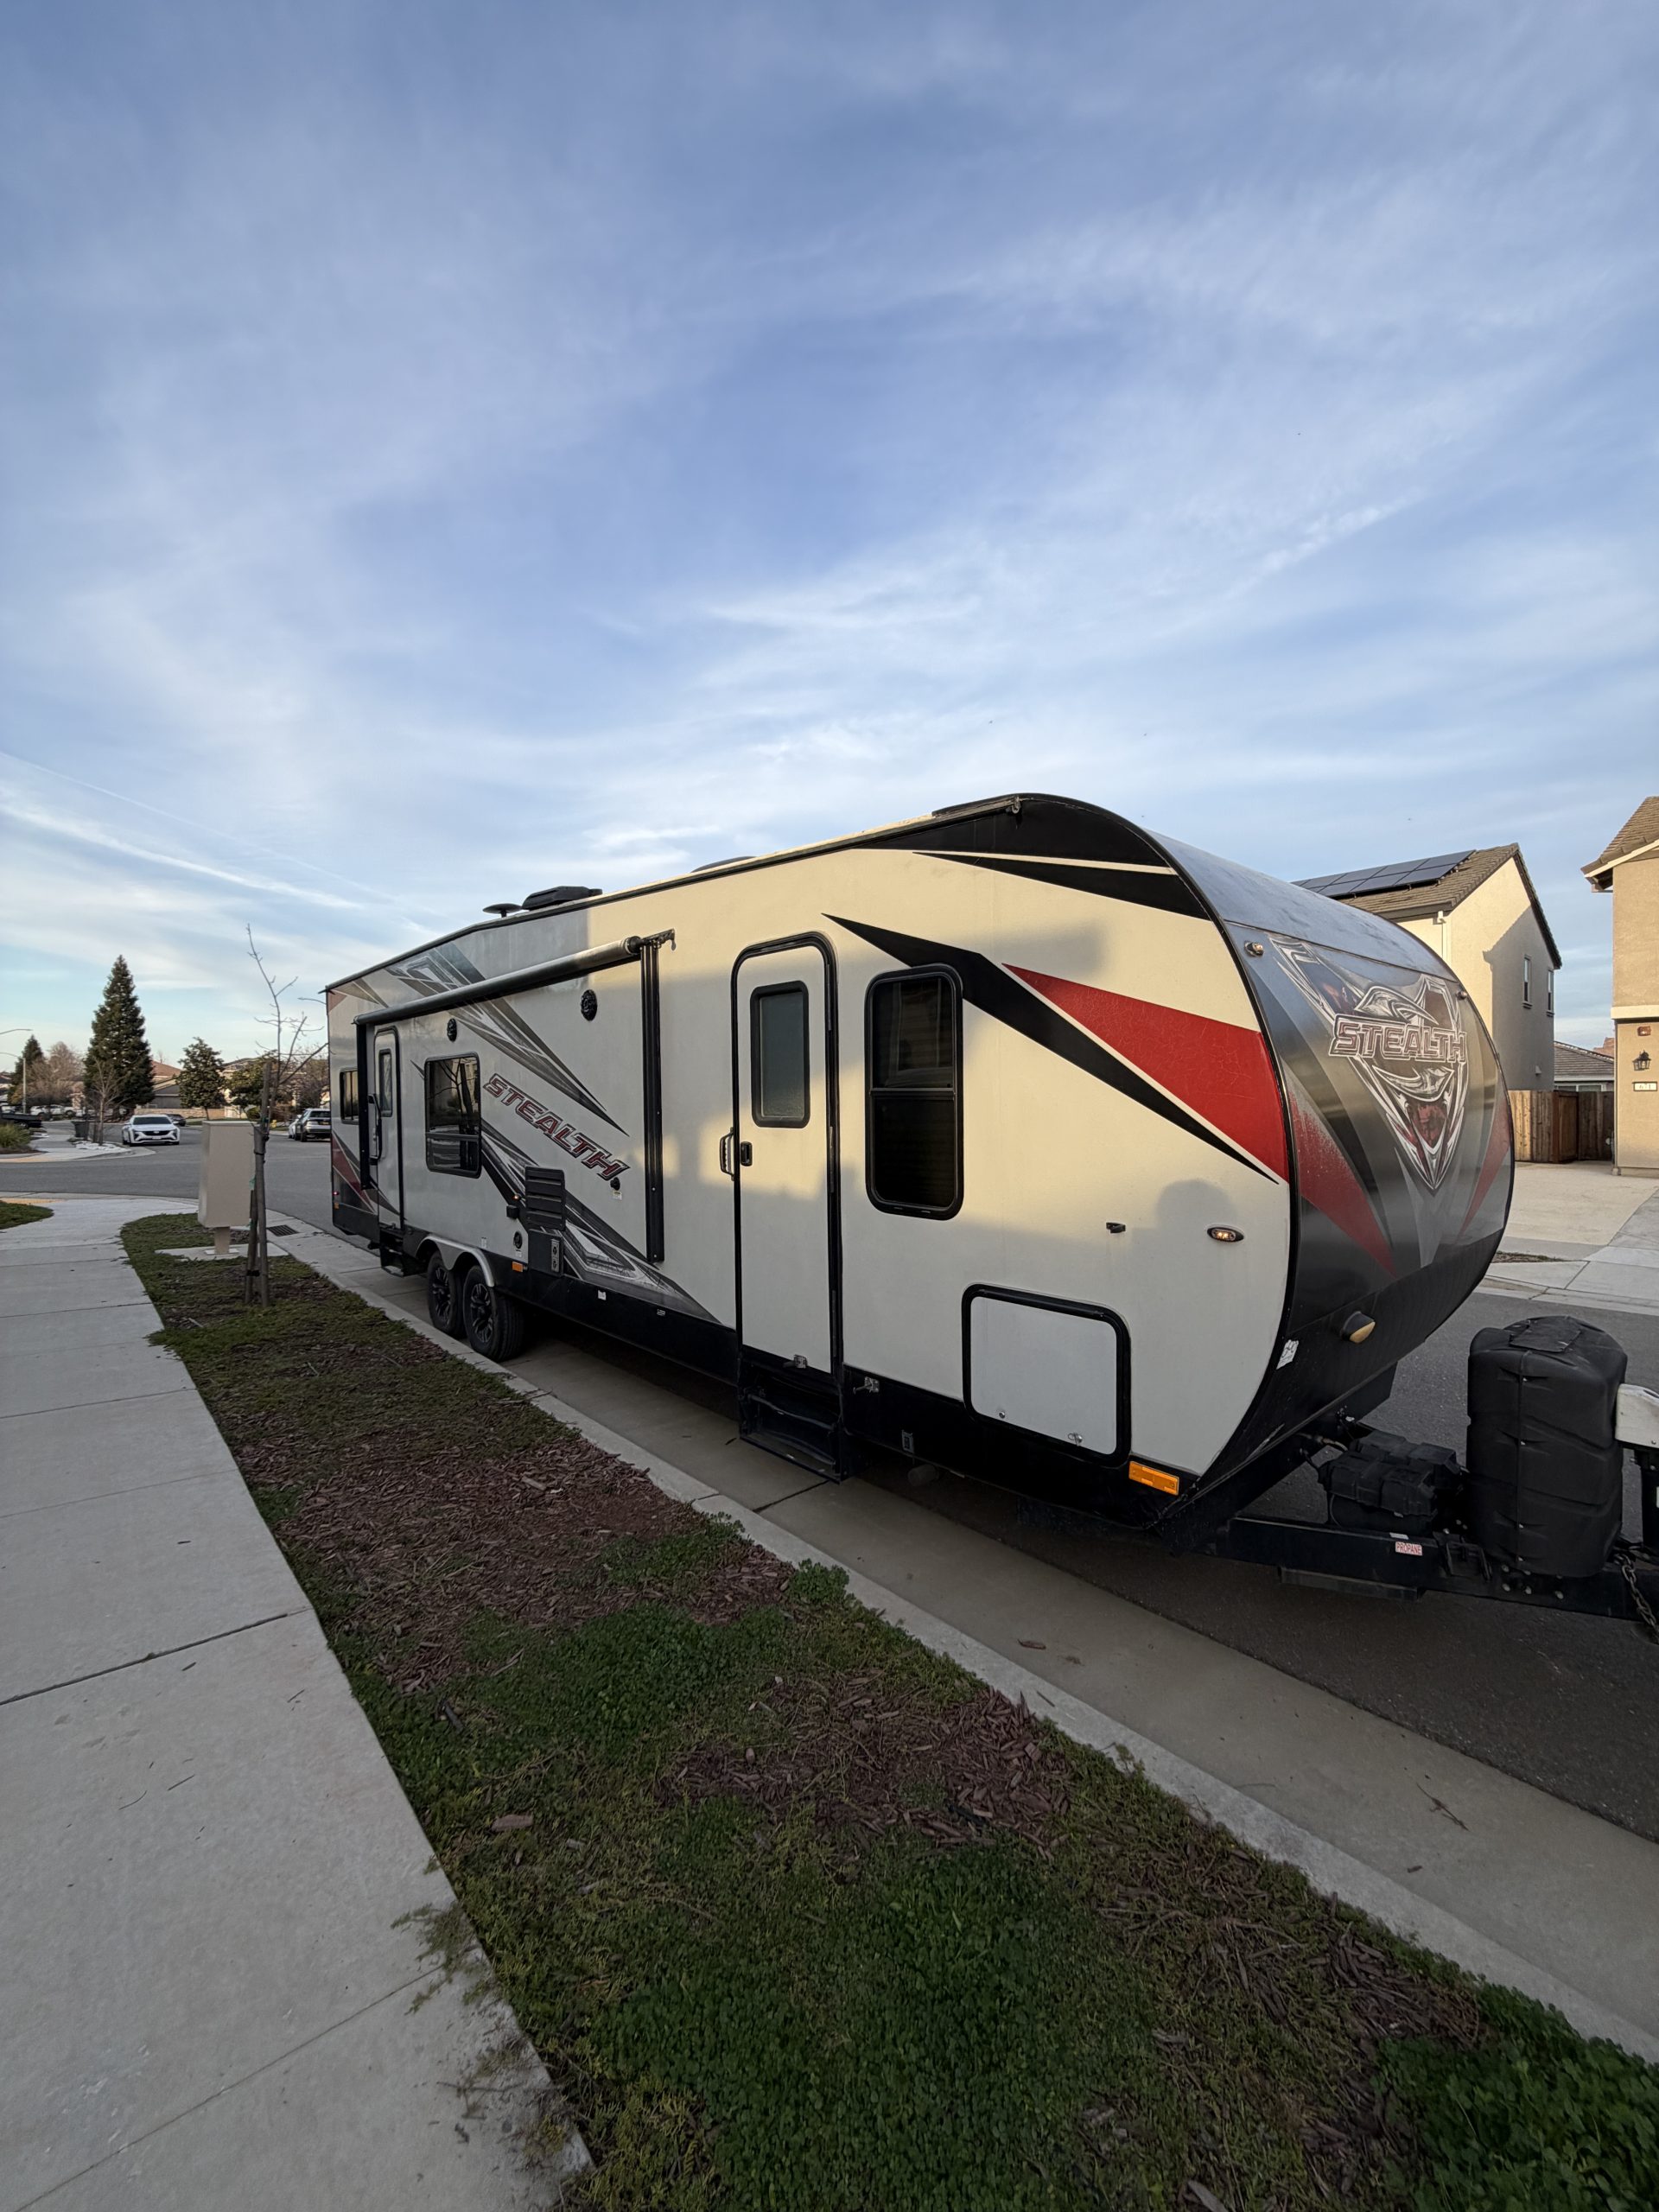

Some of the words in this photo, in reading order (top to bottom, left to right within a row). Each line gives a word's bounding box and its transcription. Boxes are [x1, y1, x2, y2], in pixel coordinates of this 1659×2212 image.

[1332, 1017, 1467, 1064] STEALTH
[484, 1074, 630, 1180] STEALTH
[1396, 1542, 1421, 1554] PROPANE
